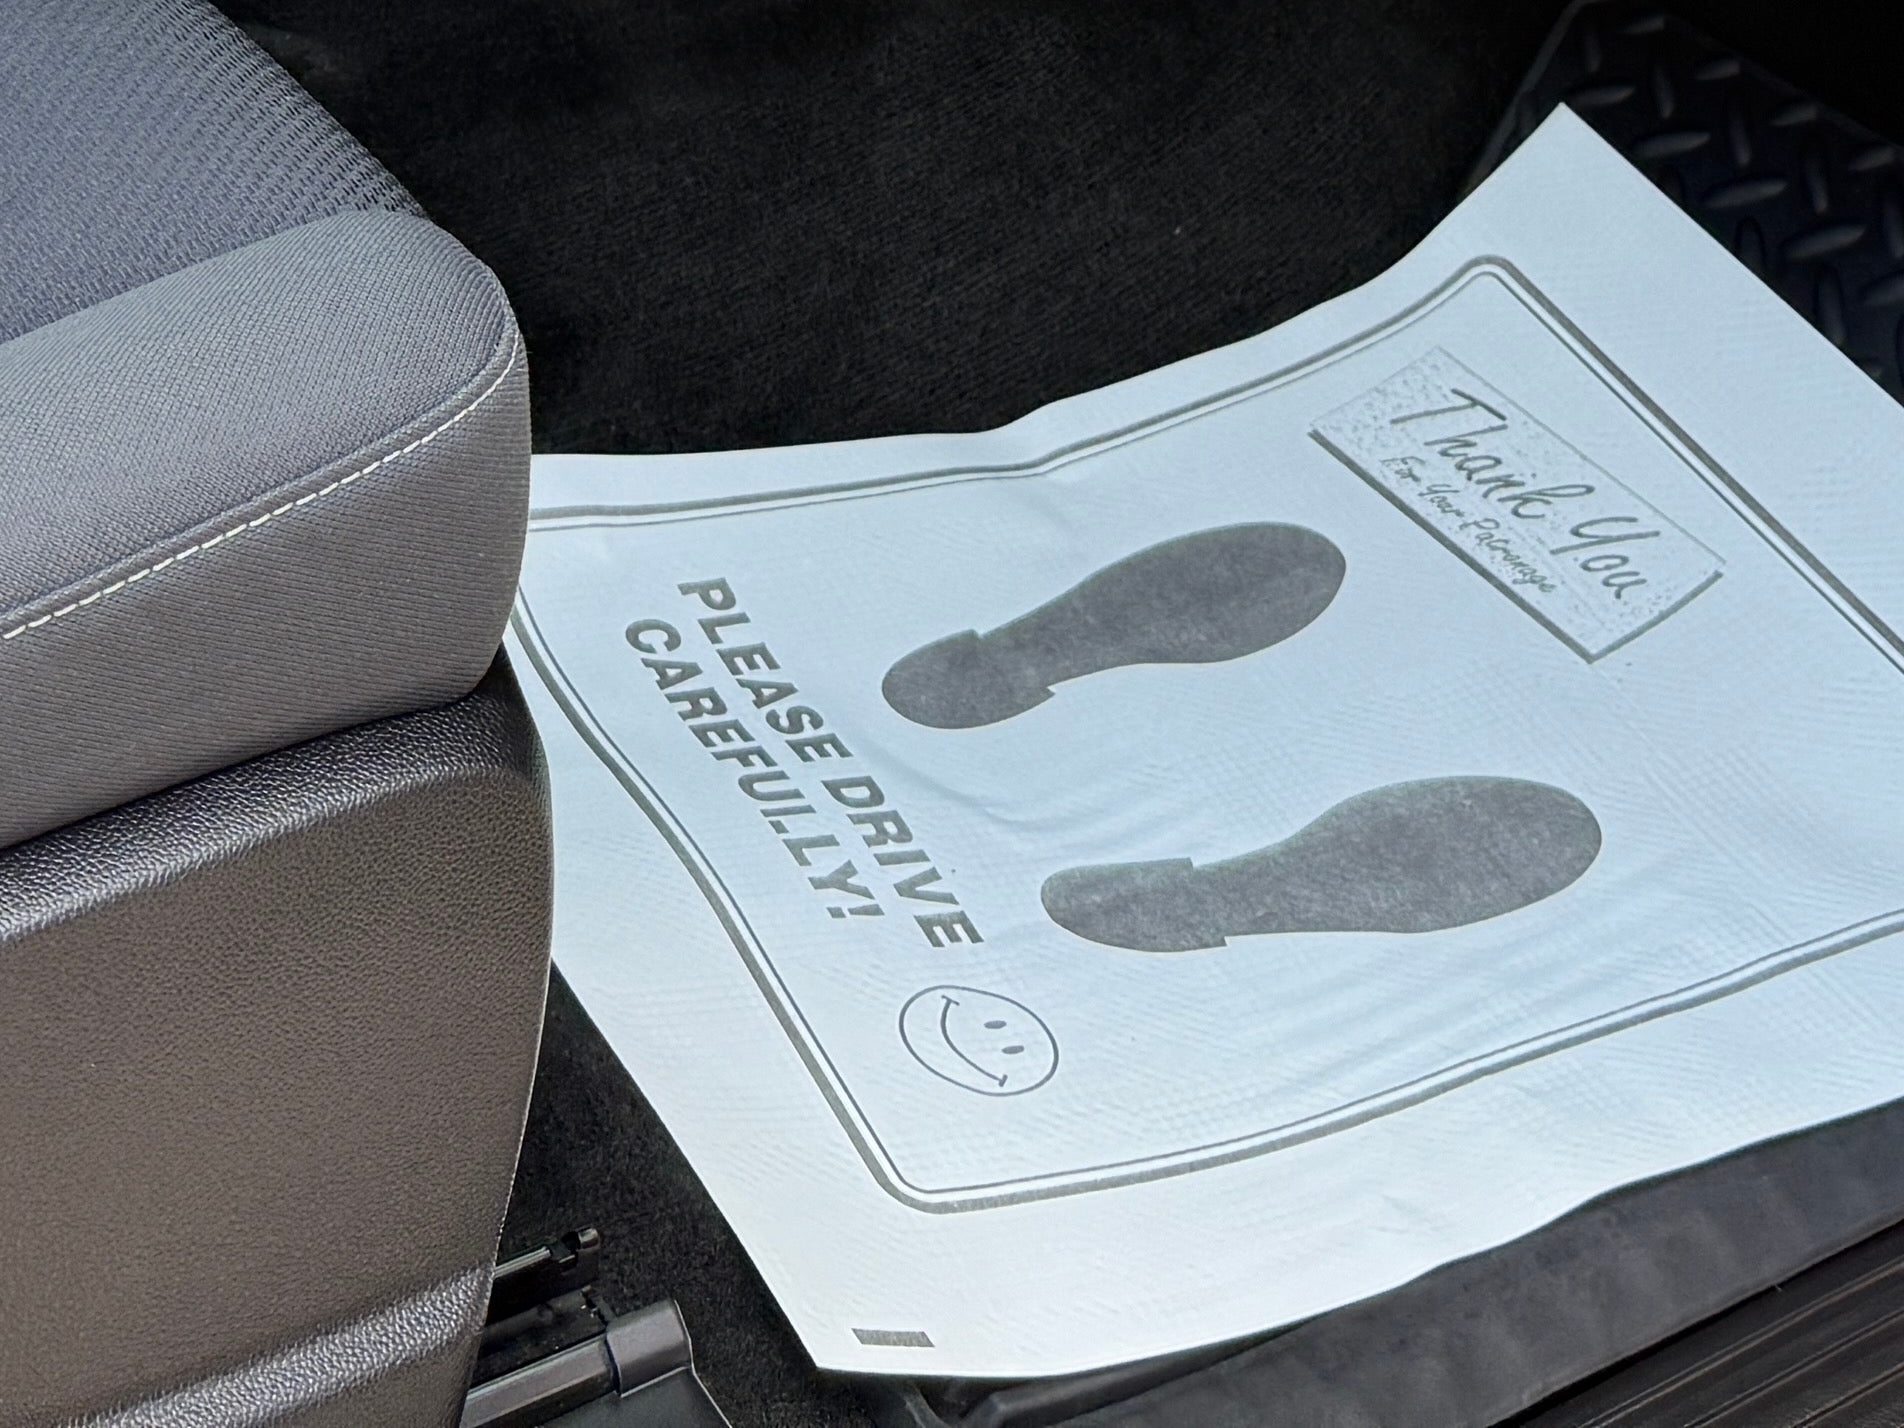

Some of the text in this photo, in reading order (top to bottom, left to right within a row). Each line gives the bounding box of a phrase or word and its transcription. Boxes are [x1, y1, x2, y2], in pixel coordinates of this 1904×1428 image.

[1381, 454, 1427, 484] For
[1458, 518, 1558, 595] Patronage
[1389, 387, 1662, 600] Thank You
[624, 617, 886, 920] CAREFULLY!
[677, 576, 986, 949] PLEASE DRIVE
